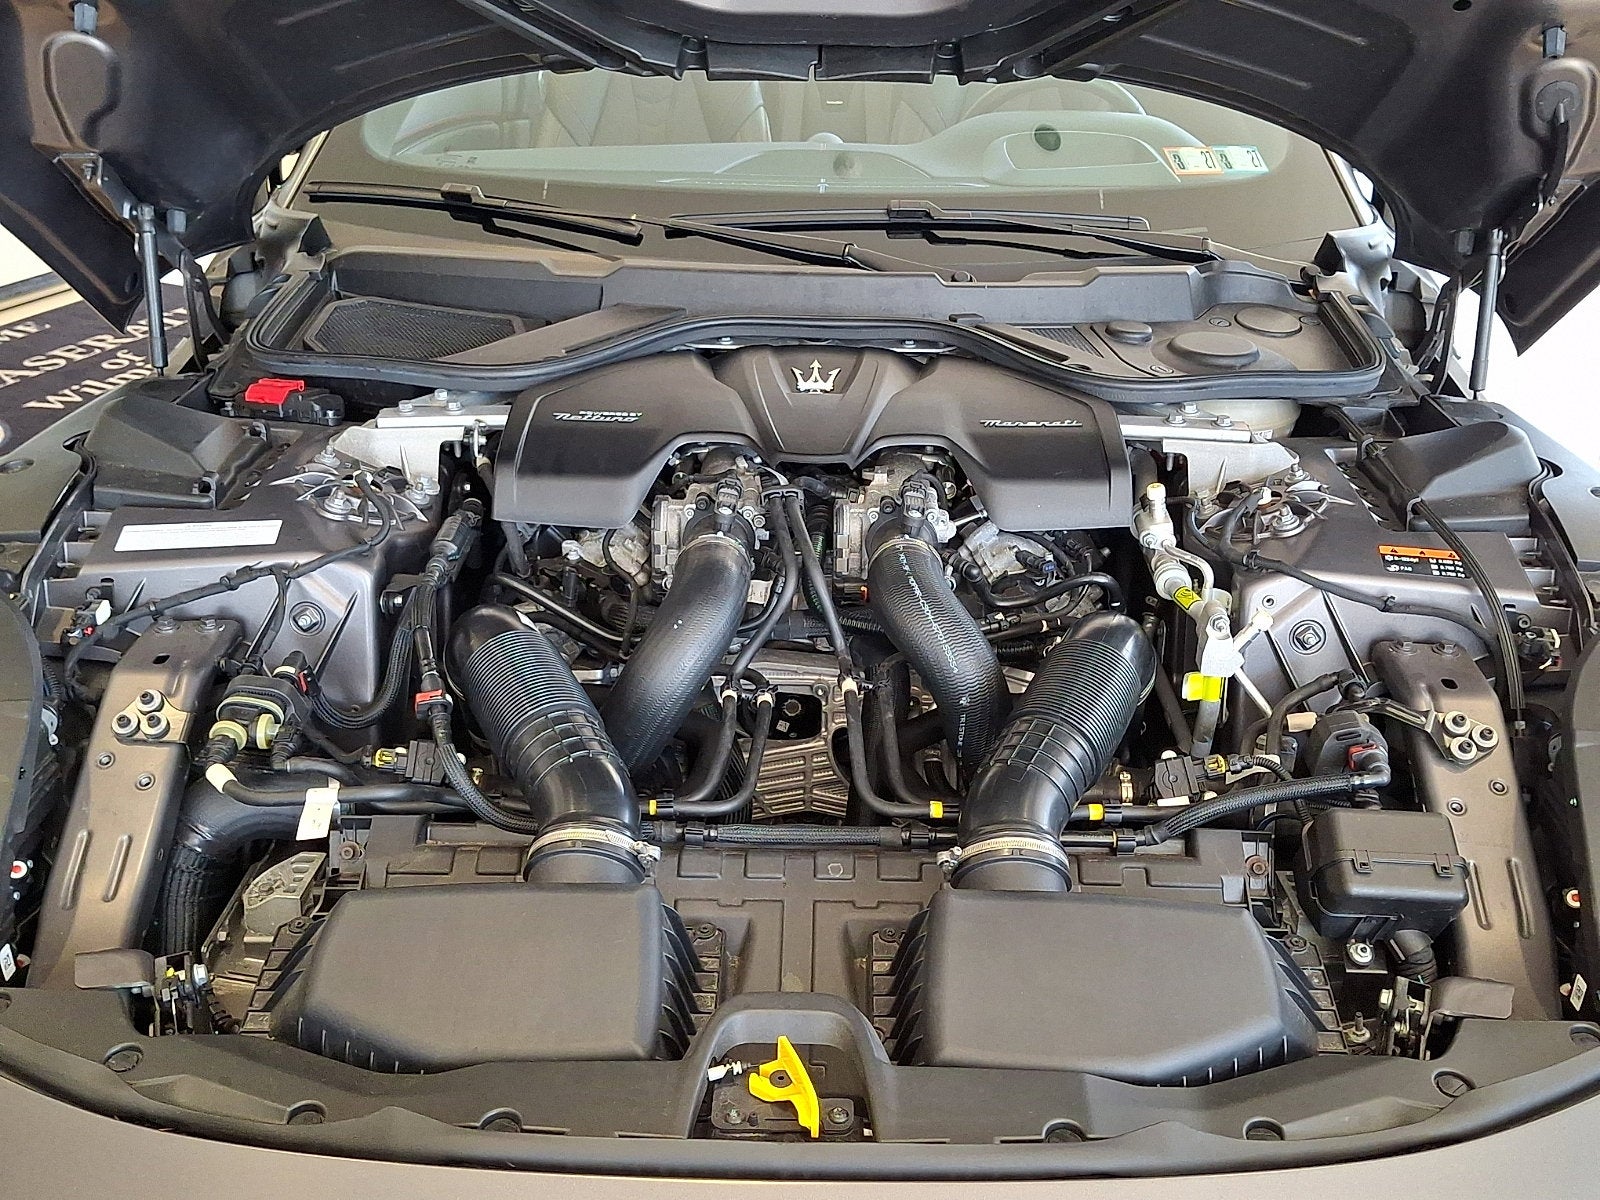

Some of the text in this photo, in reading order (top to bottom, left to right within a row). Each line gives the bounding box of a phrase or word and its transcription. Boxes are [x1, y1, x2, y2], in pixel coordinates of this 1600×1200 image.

[1172, 153, 1186, 170] 3
[1219, 153, 1233, 170] 3
[101, 349, 147, 370] of
[980, 419, 1083, 428] Maserati
